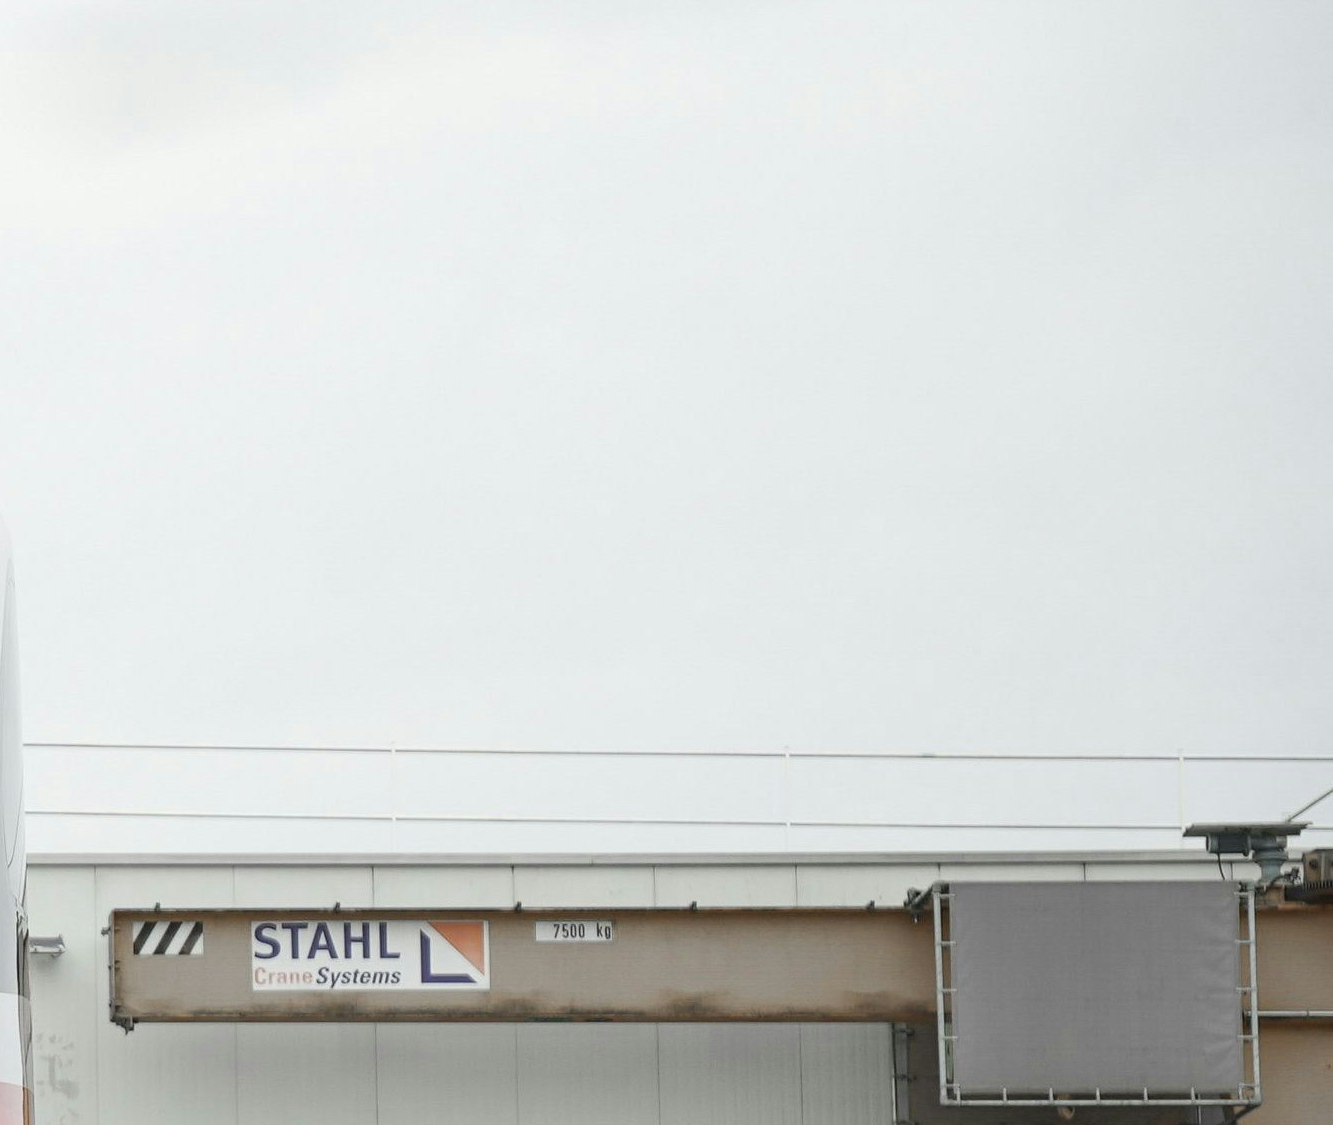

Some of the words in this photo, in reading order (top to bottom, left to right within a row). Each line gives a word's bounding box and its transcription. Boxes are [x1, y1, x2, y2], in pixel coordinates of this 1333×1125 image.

[253, 921, 401, 960] STAHL
[553, 923, 585, 939] 7500
[596, 922, 612, 939] kg
